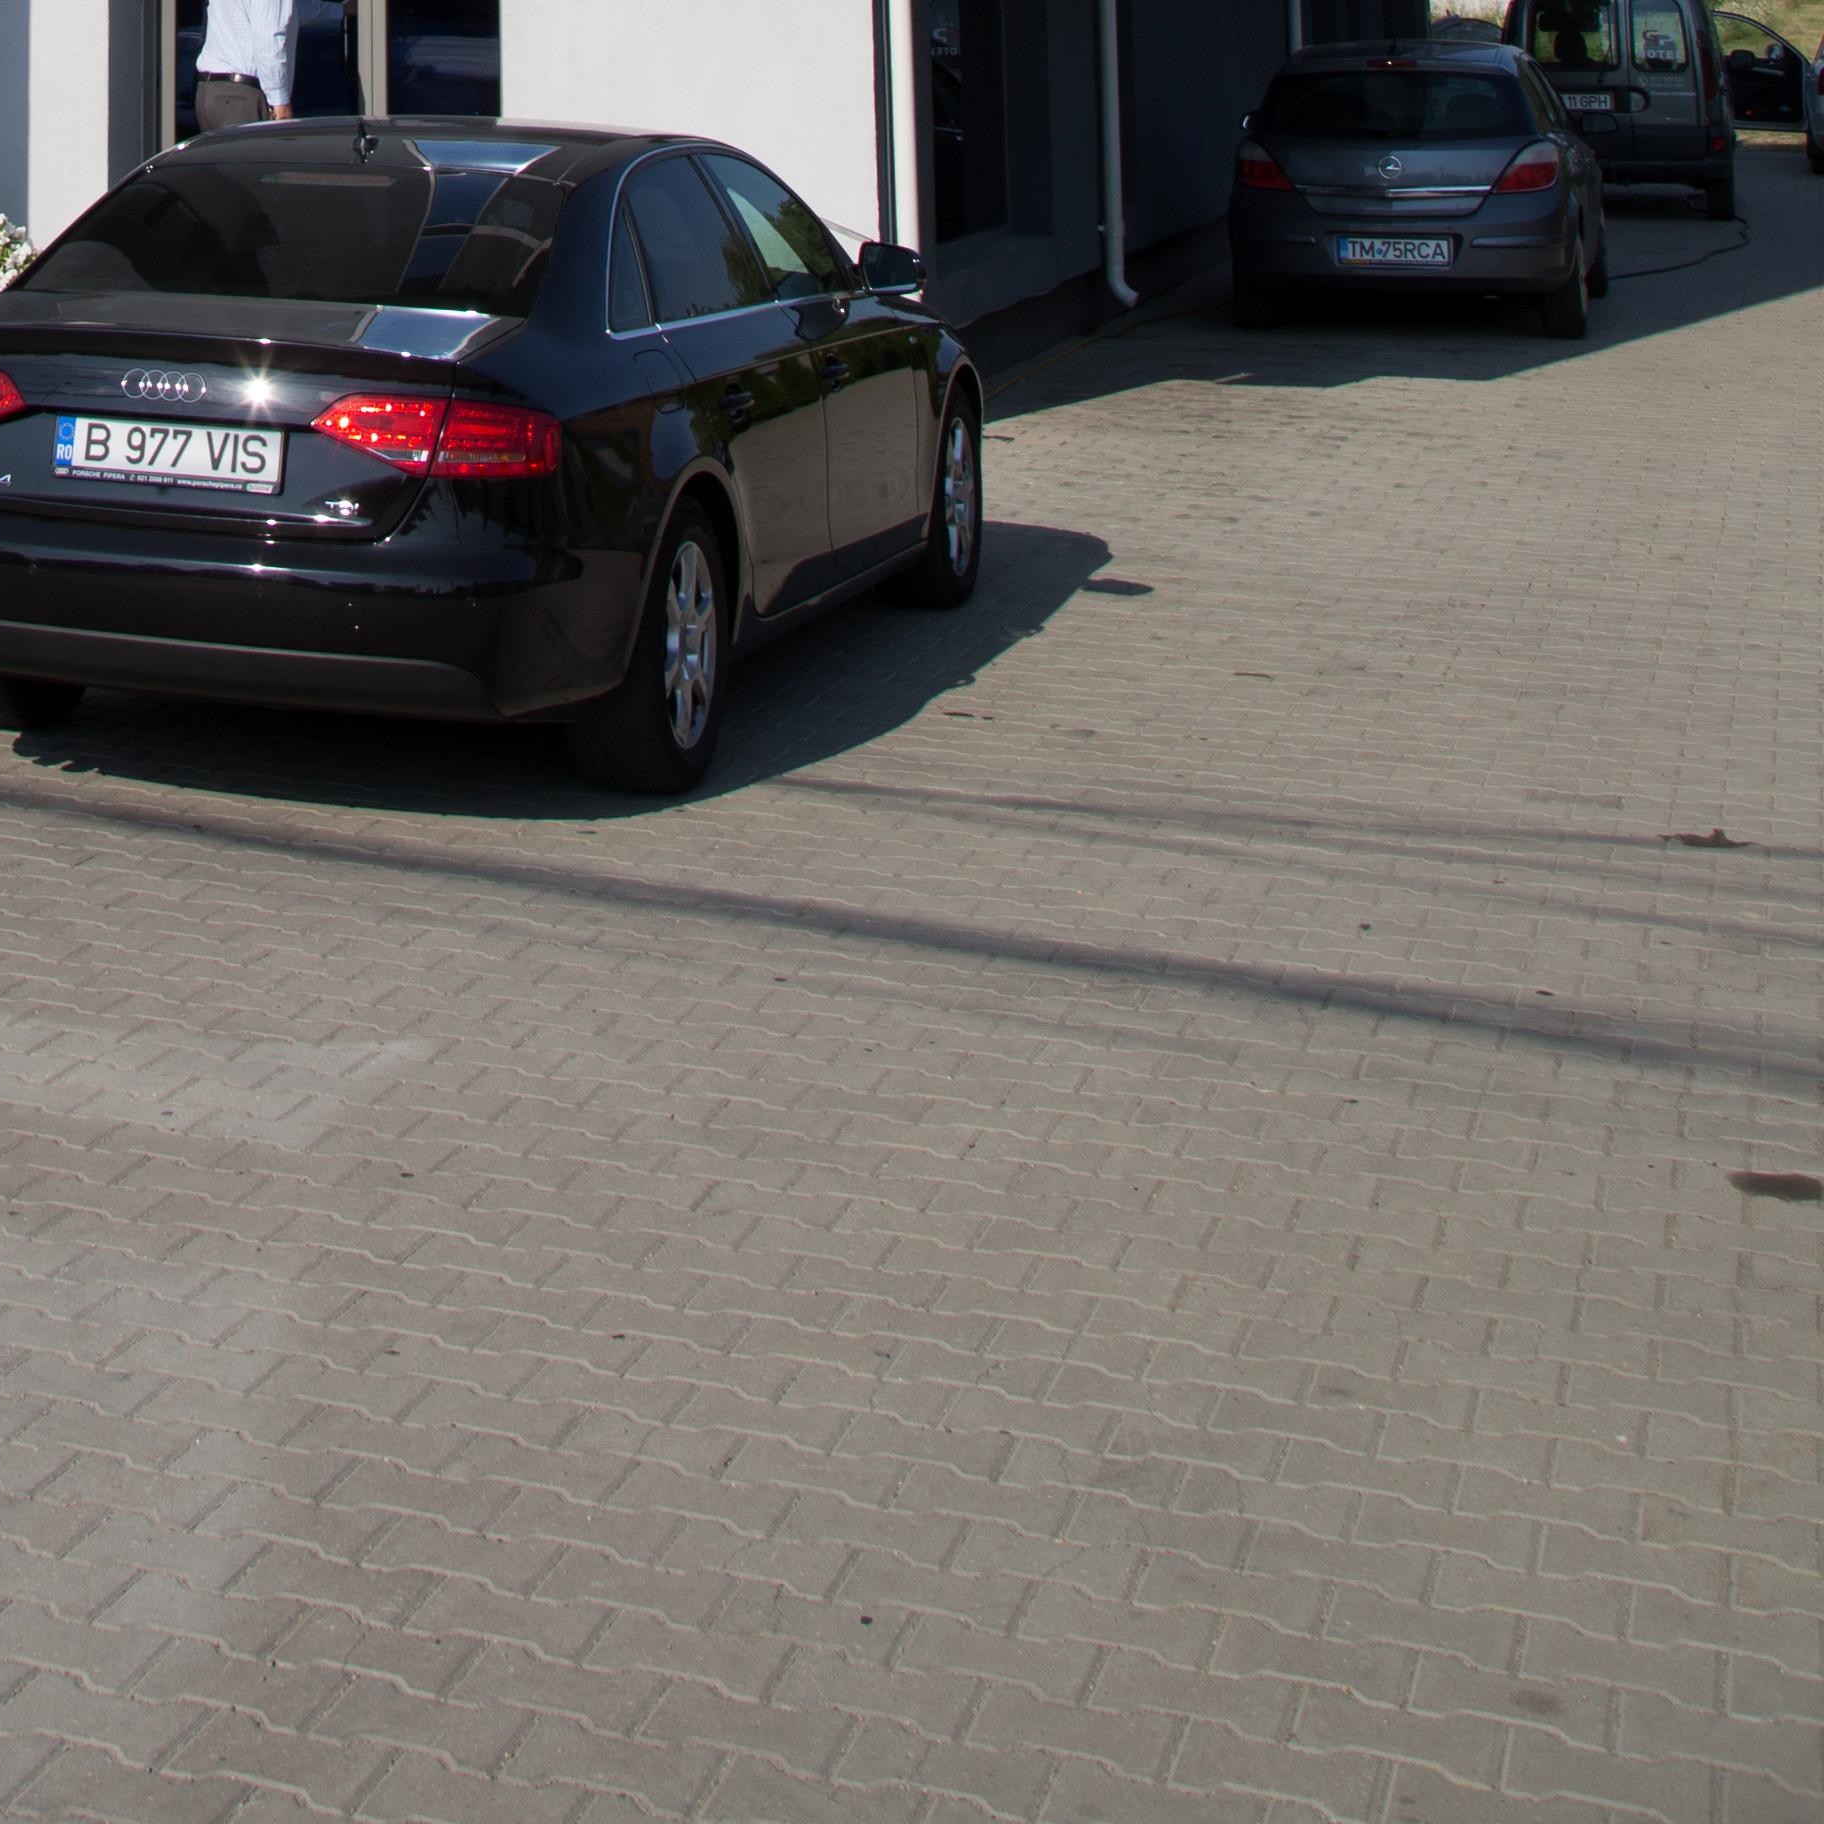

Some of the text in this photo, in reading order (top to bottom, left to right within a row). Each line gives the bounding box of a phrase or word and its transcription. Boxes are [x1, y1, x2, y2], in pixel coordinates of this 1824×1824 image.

[1580, 95, 1608, 107] GPH
[1349, 240, 1375, 258] TM
[56, 444, 73, 460] RO
[85, 422, 268, 474] B 977 VIS
